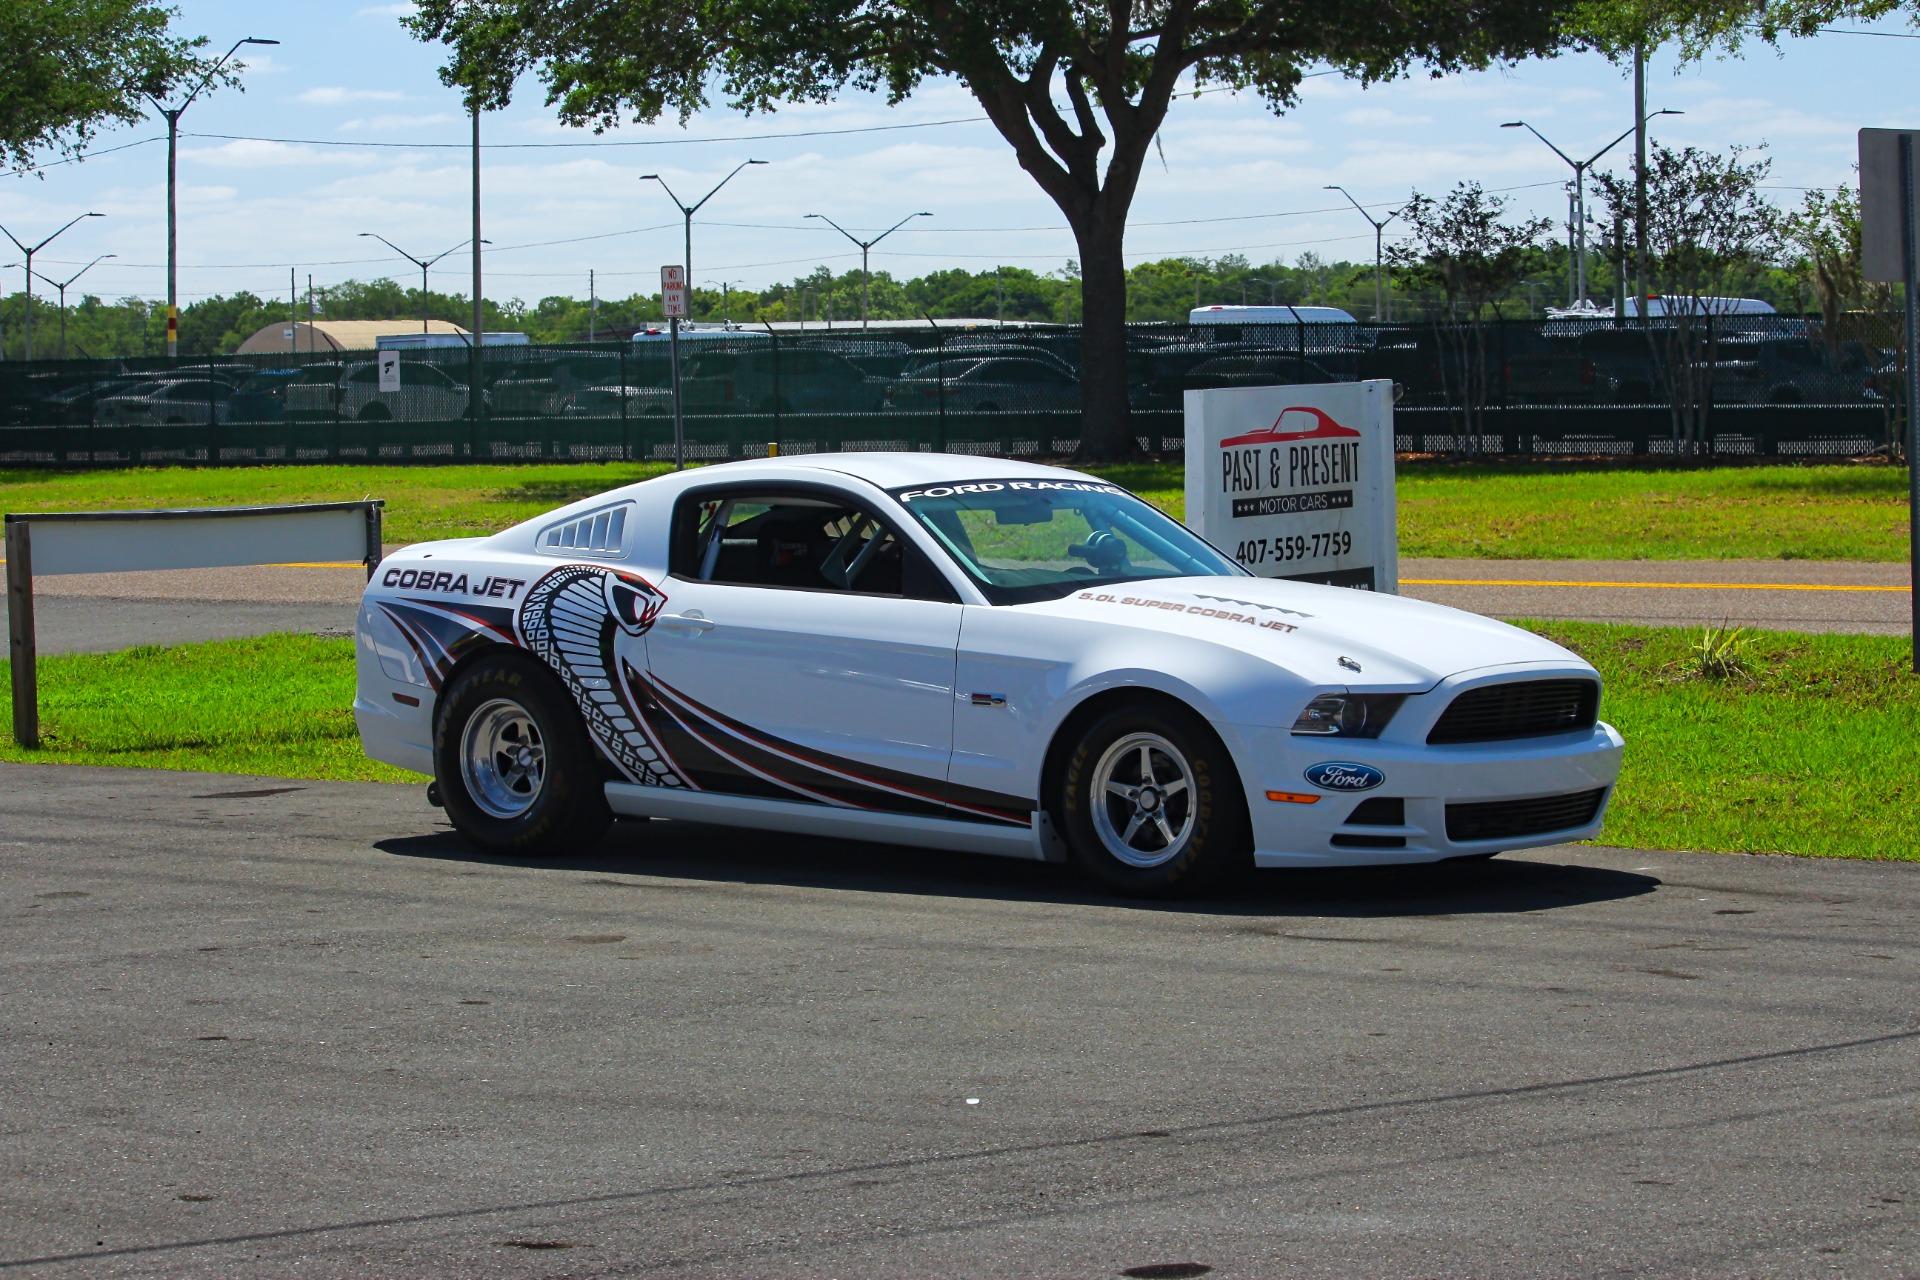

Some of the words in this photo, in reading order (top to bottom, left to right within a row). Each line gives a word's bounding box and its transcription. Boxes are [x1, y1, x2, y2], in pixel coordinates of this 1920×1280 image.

[664, 281, 684, 290] PARKING
[668, 269, 677, 280] NO
[1223, 449, 1261, 492] PAST
[1270, 448, 1280, 489] &
[1289, 442, 1359, 487] PRESENT
[899, 482, 1004, 502] FORD
[1008, 481, 1127, 497] RACING
[1259, 498, 1297, 513] MOTOR
[1300, 494, 1328, 511] CARS
[1235, 530, 1352, 565] 407-559-7759
[382, 567, 468, 595] COBRA
[472, 575, 527, 599] JET
[1078, 592, 1116, 603] 5.0L
[1120, 597, 1186, 612] SUPER
[1186, 606, 1256, 626] COBRA
[1259, 620, 1298, 634] JET
[1320, 765, 1369, 787] Ford
